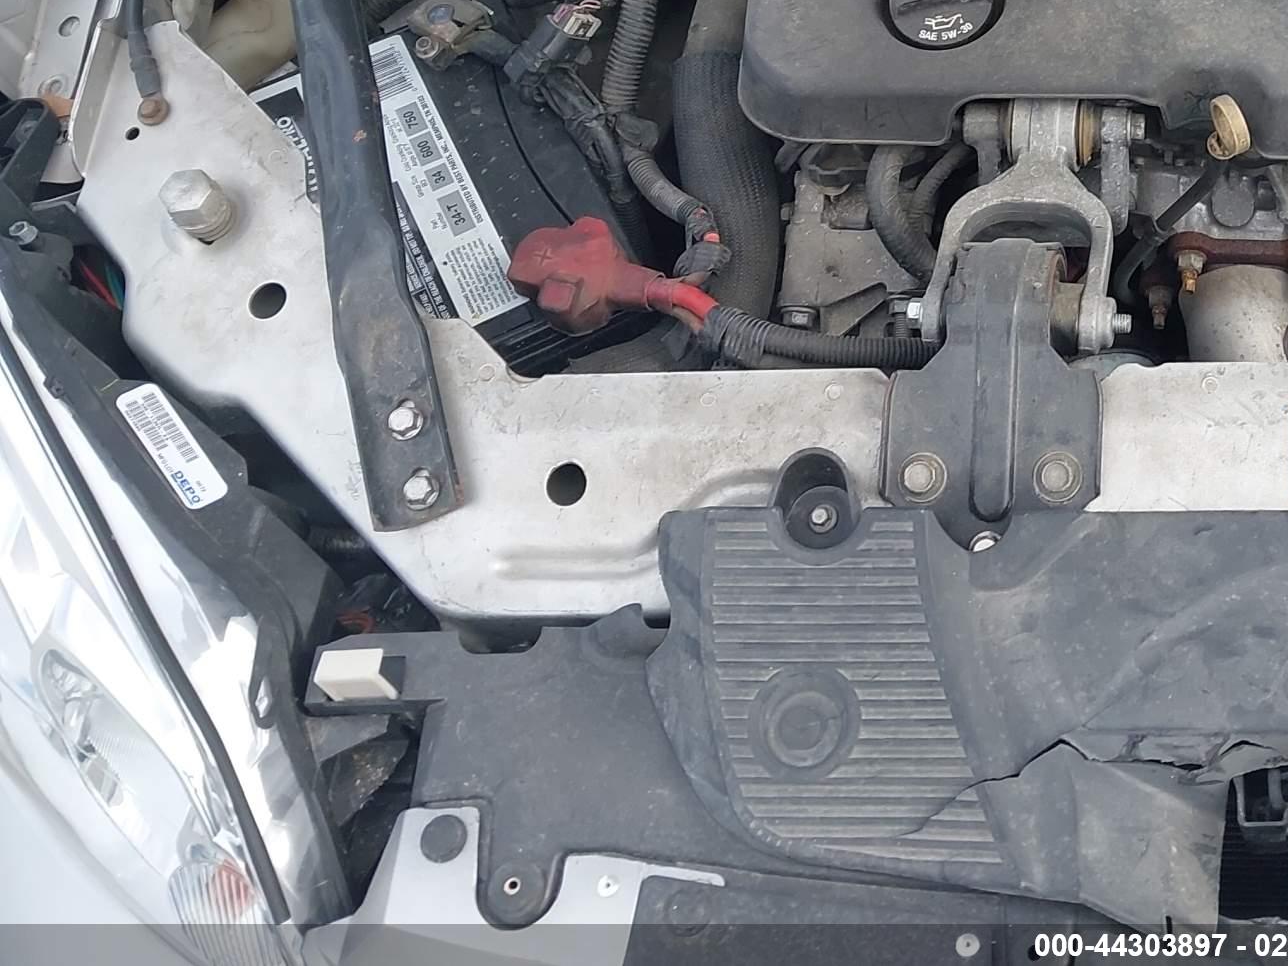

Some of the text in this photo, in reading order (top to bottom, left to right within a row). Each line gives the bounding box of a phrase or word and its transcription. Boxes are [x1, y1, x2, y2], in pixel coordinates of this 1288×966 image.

[919, 22, 974, 41] SAE 5W-30
[402, 107, 419, 128] 750
[416, 137, 434, 158] 600
[431, 168, 447, 184] 34
[452, 169, 464, 184] BEST
[445, 200, 466, 227] 34-T
[463, 189, 483, 224] DISTRIBUTED
[426, 279, 440, 296] REACH
[174, 470, 201, 504] DEPO
